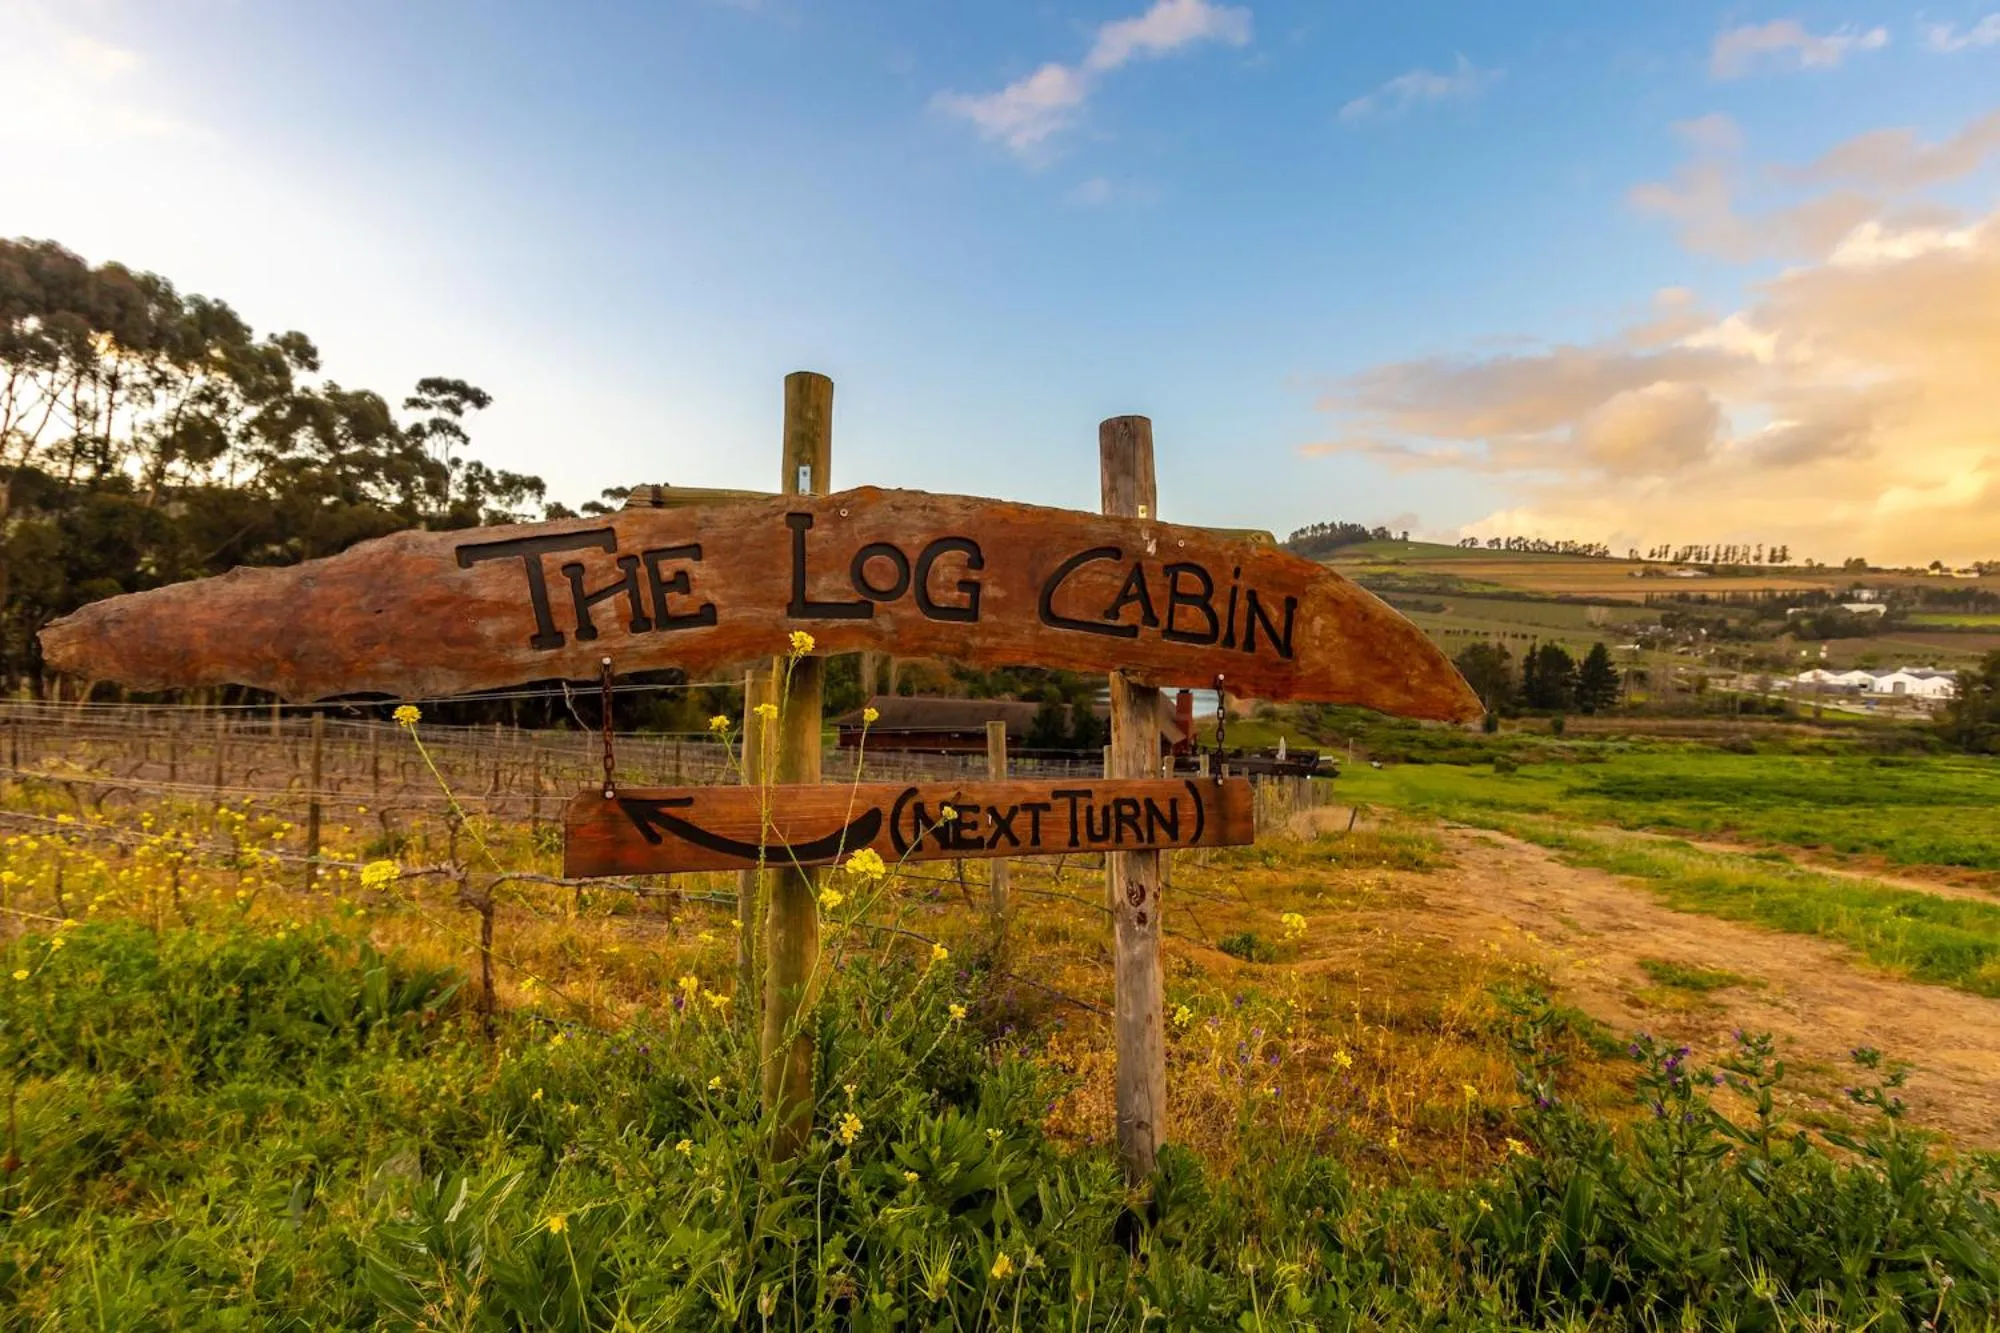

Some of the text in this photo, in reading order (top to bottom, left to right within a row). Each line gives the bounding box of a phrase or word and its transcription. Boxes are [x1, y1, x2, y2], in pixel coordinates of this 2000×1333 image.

[455, 526, 718, 651] THE
[785, 512, 985, 622] LOG
[889, 779, 1205, 857] (NEXT TURN)
